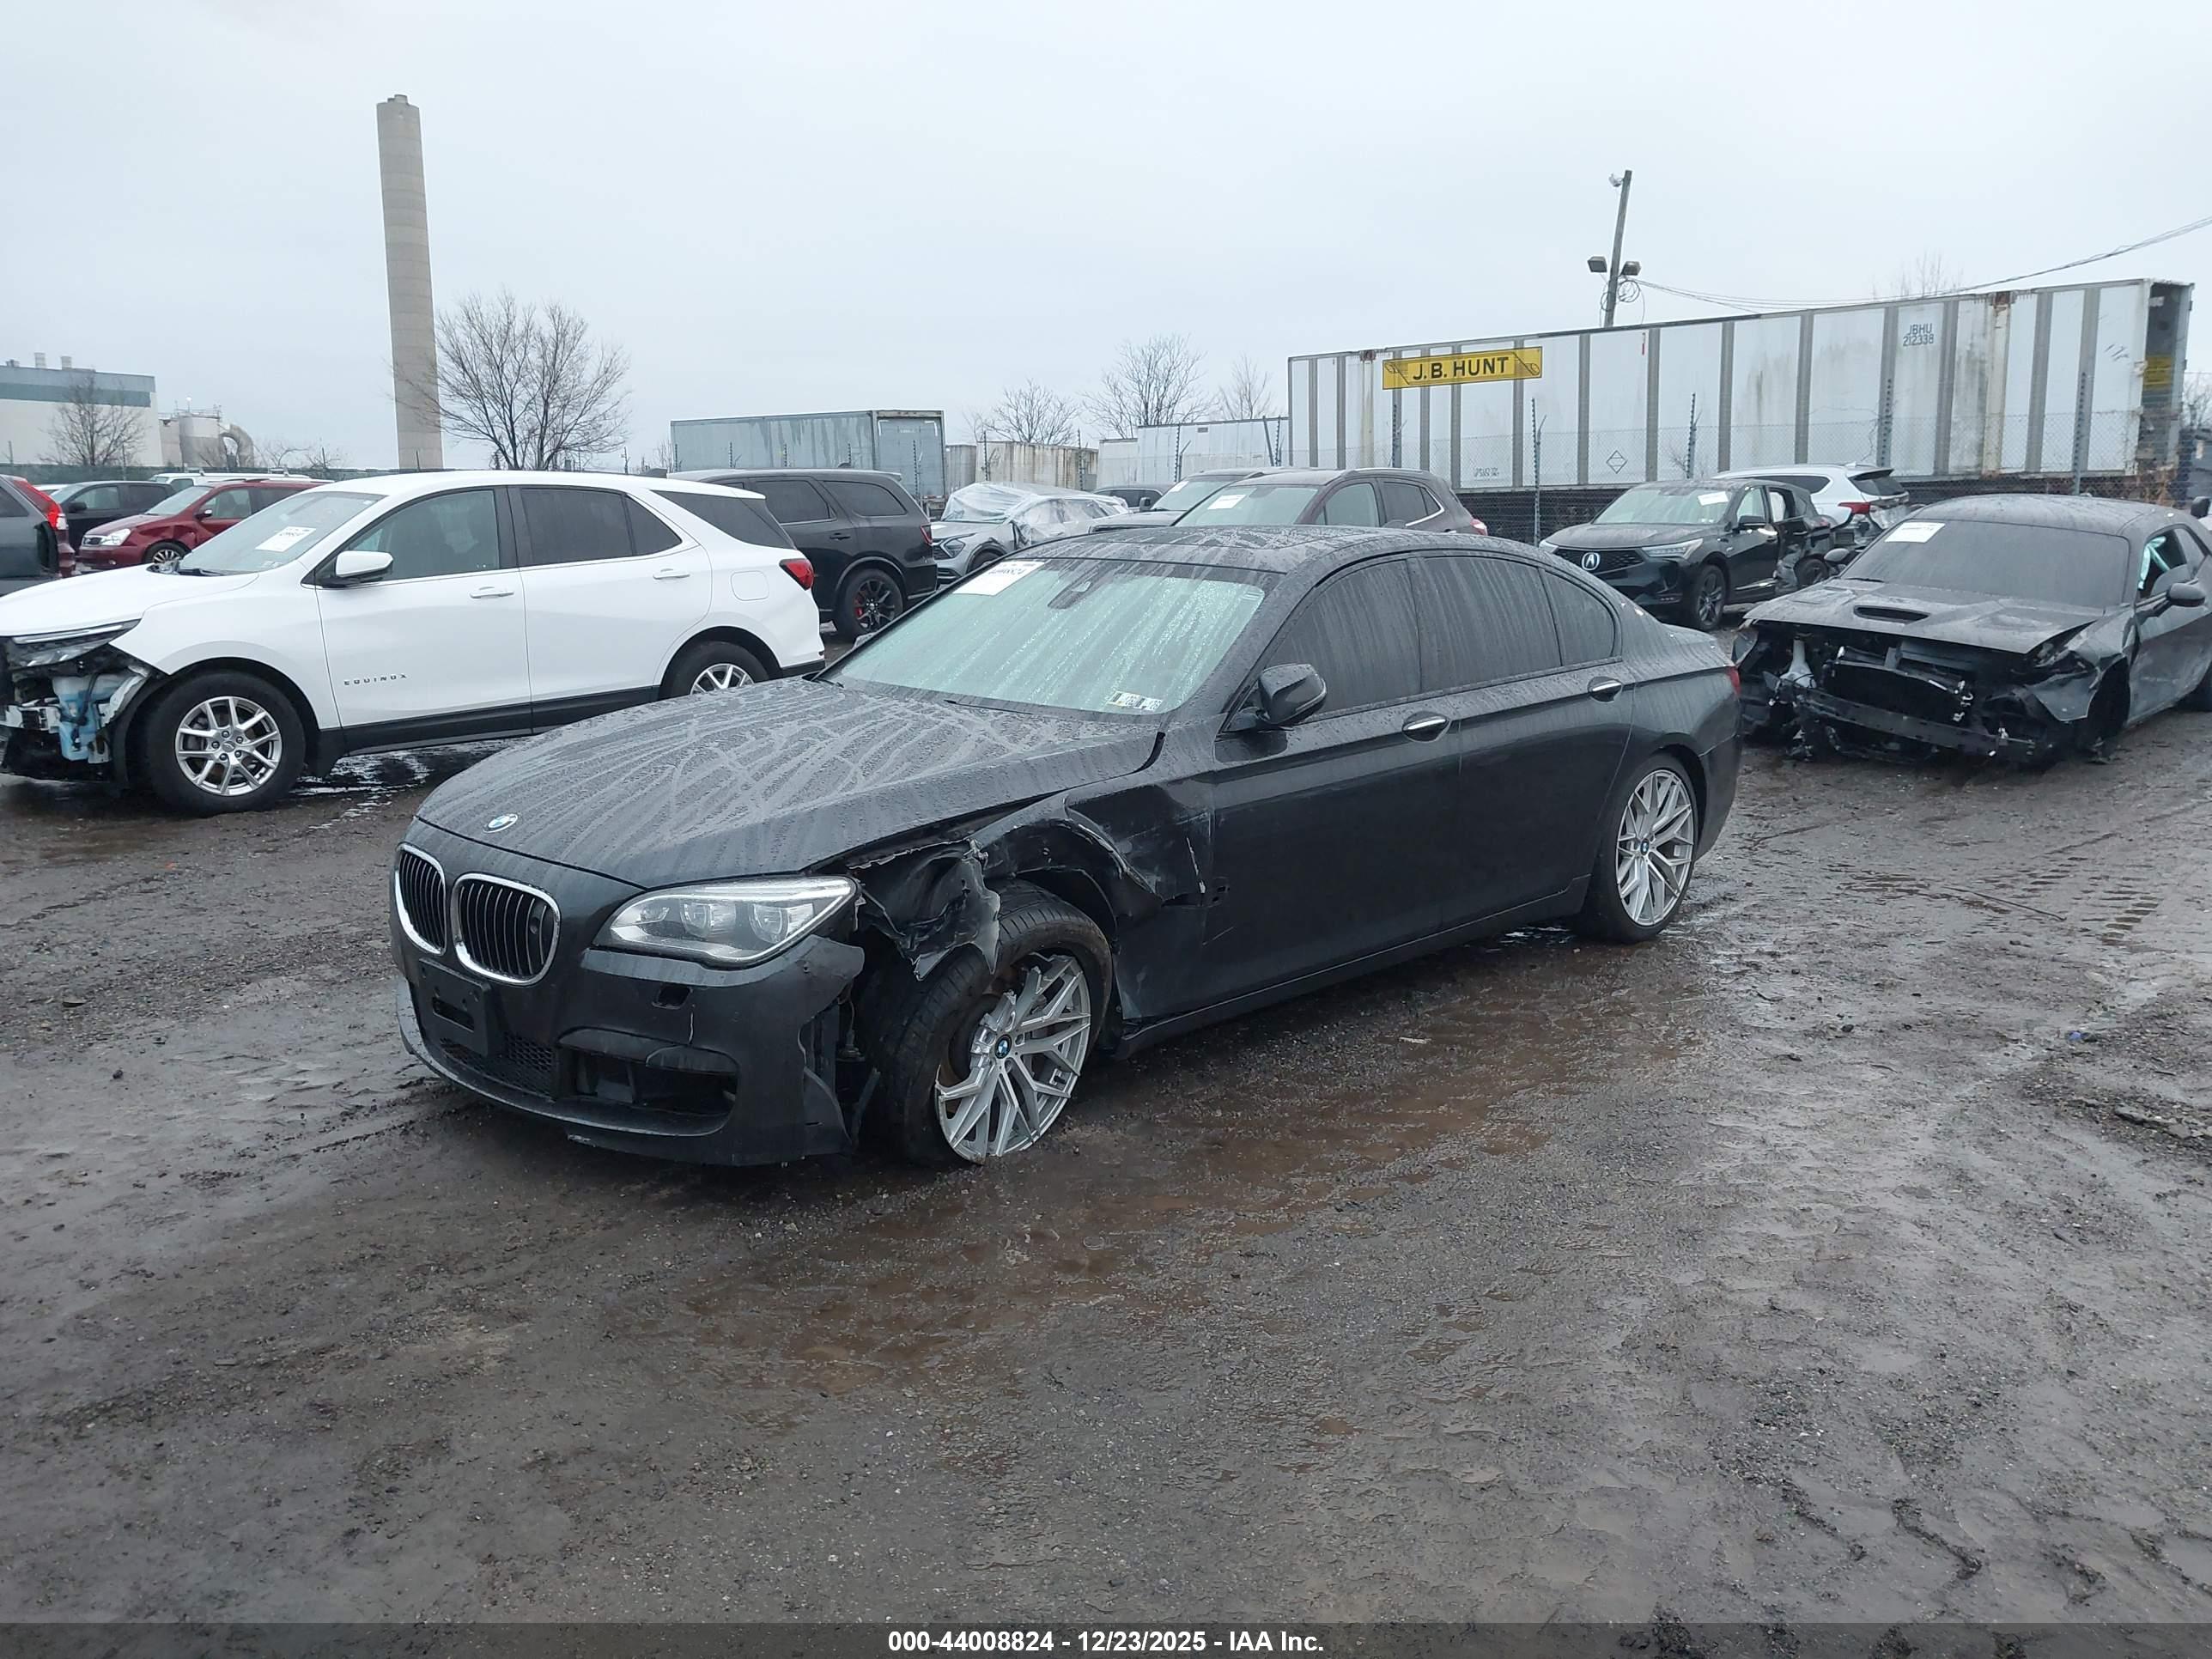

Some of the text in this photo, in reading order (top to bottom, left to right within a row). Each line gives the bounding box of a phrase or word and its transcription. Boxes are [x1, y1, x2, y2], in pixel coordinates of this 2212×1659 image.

[1907, 323, 1933, 336] JBHU
[1902, 333, 1935, 347] 212338
[1453, 356, 1509, 377] HUNT
[343, 674, 407, 686] EQUINOX
